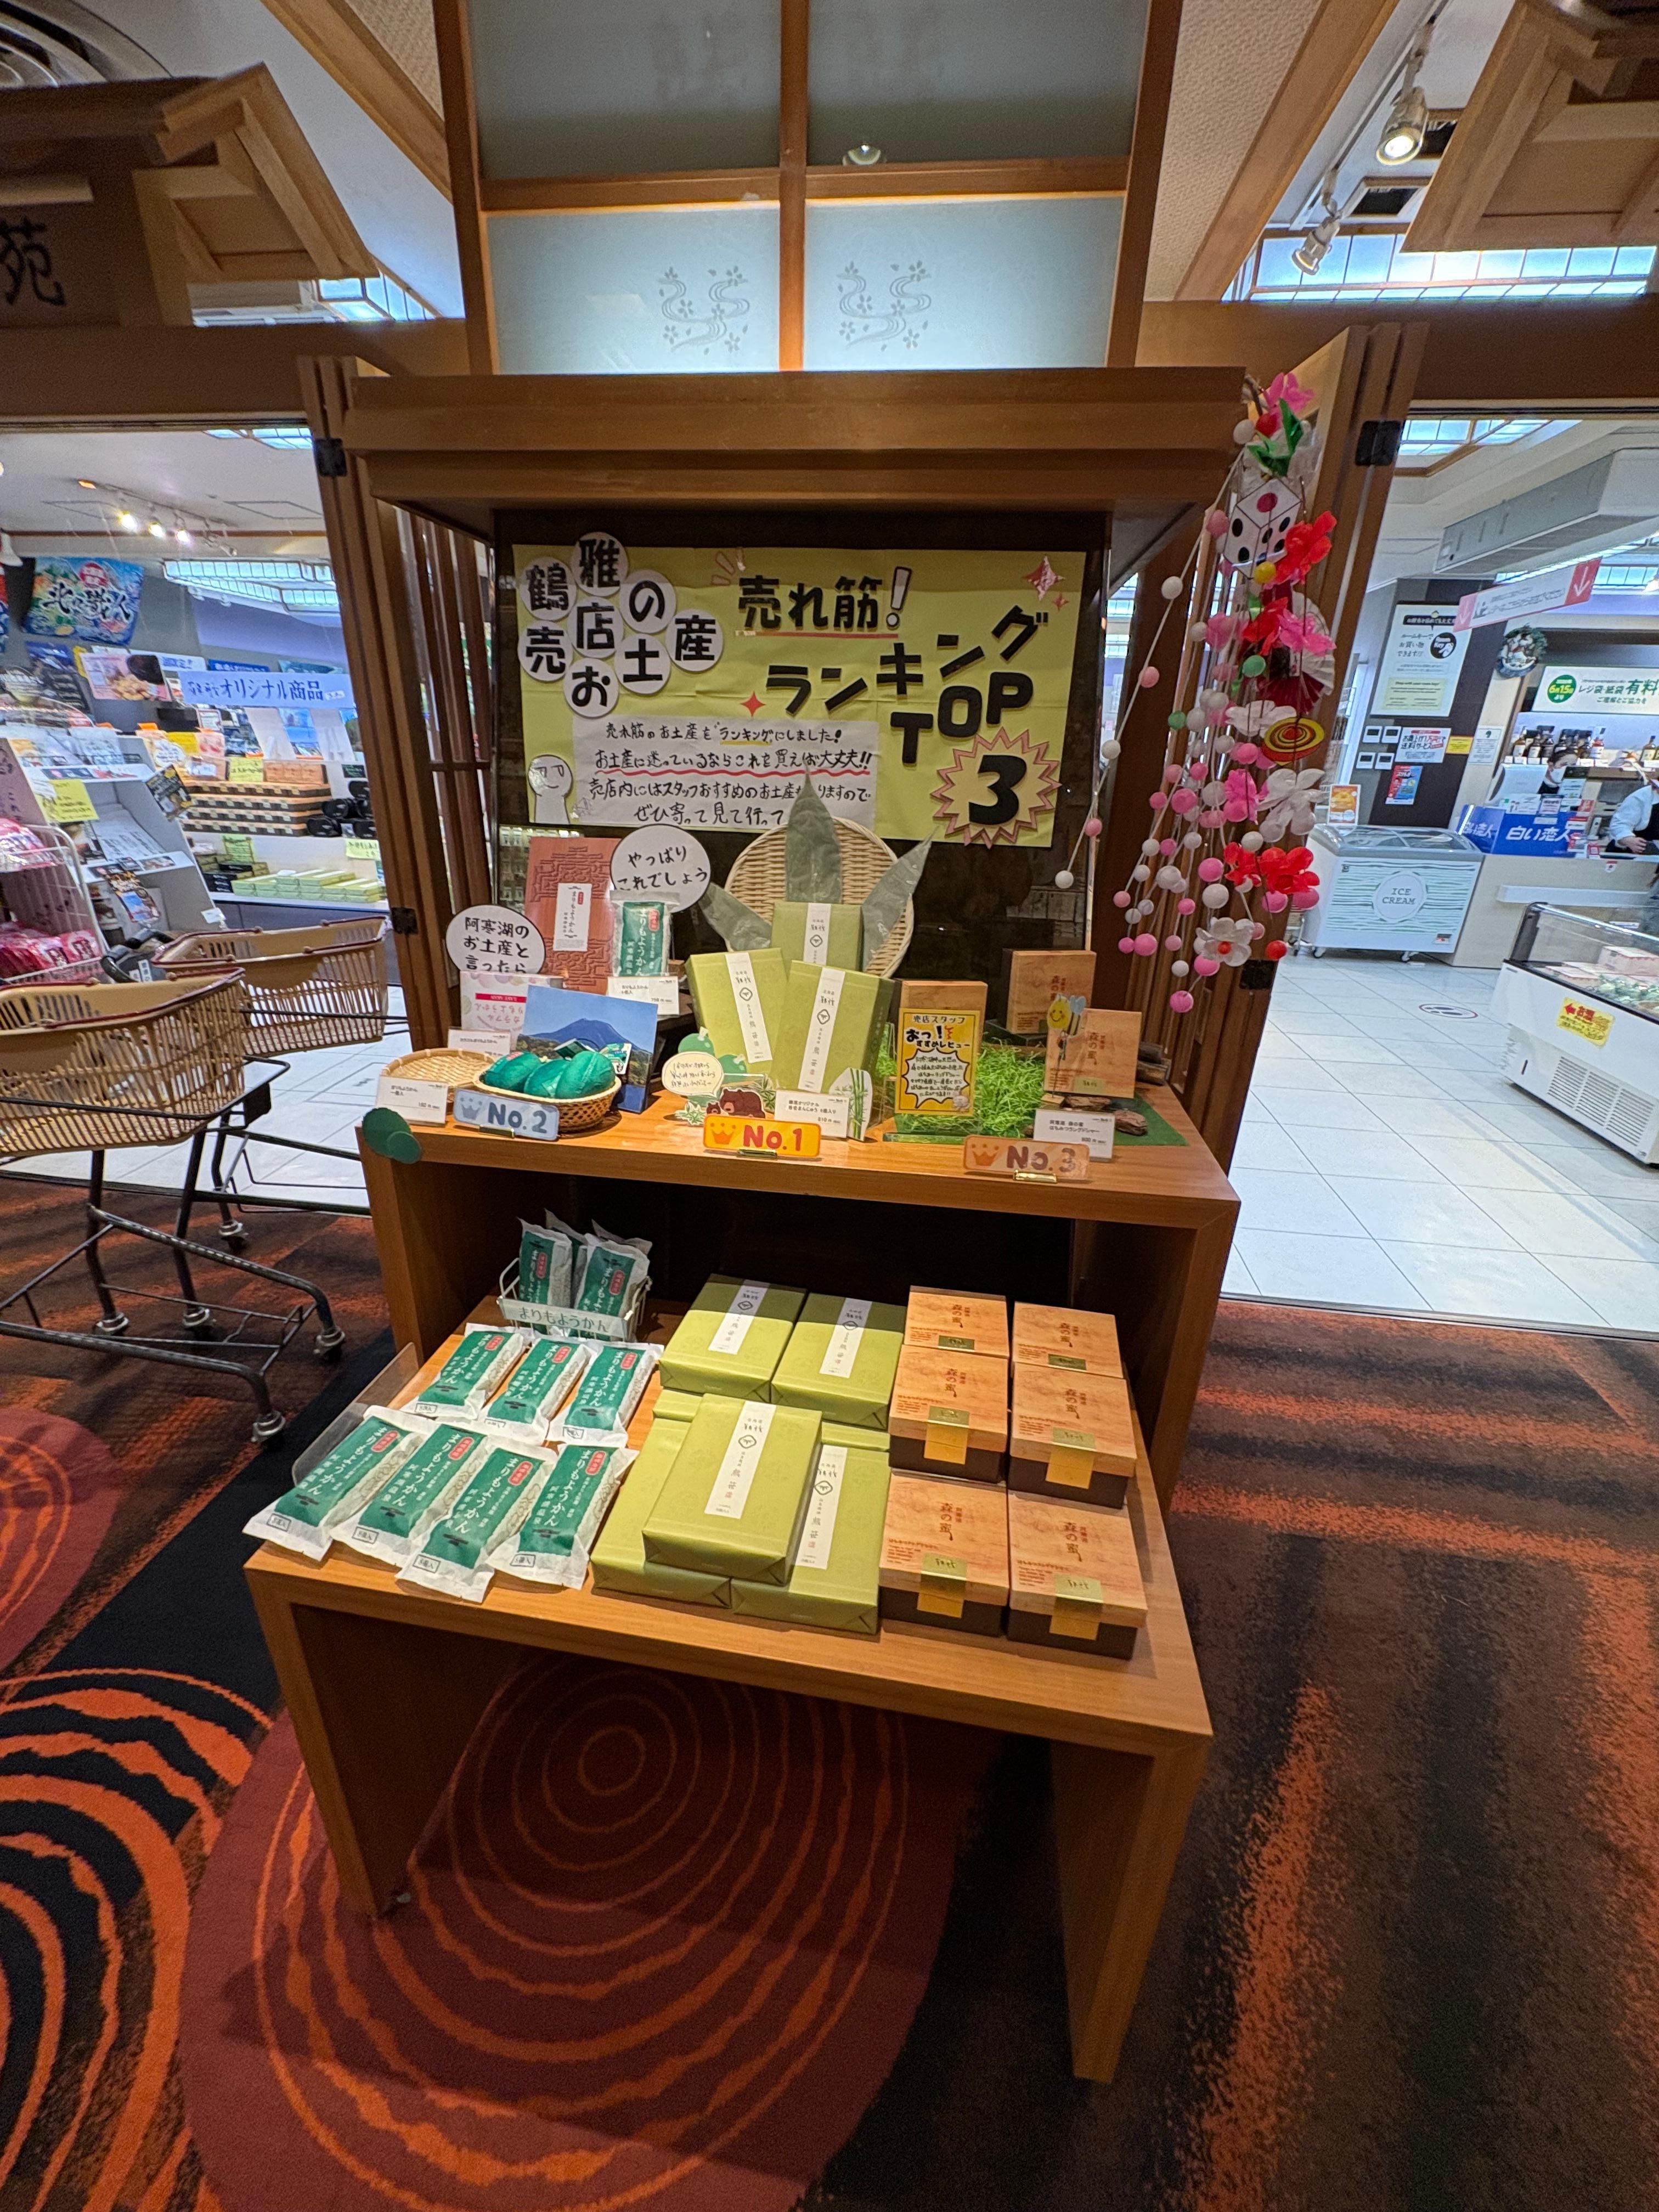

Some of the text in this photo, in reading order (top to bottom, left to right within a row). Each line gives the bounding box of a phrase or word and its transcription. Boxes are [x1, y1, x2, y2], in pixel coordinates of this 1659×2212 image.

[0, 217, 66, 306] 苑
[737, 566, 912, 630] 売れ筋!
[766, 605, 1048, 716] ランキング
[890, 672, 1034, 764] TOP
[968, 754, 1027, 825] 3
[1505, 825, 1570, 843] 白い恋人
[628, 846, 686, 868] やっぱり
[616, 868, 708, 890] これでしょう
[1391, 887, 1412, 896] ICE
[1381, 896, 1417, 905] CREAM
[464, 916, 529, 938] 阿寒湖の
[463, 935, 529, 958] お土産と
[465, 955, 527, 973] 言ったら
[913, 1015, 966, 1024] 売店スタッフ
[488, 1101, 548, 1135] No.2
[742, 1125, 803, 1152] No.1
[1006, 1145, 1077, 1173] No.3
[518, 1307, 609, 1333] まりもようかん
[589, 1350, 625, 1407] まりもようかん
[307, 1426, 388, 1496] まりもようかん
[391, 1432, 462, 1508] まりもようかん
[454, 1457, 520, 1534] まりもようかん
[544, 1449, 592, 1527] まりもようかん
